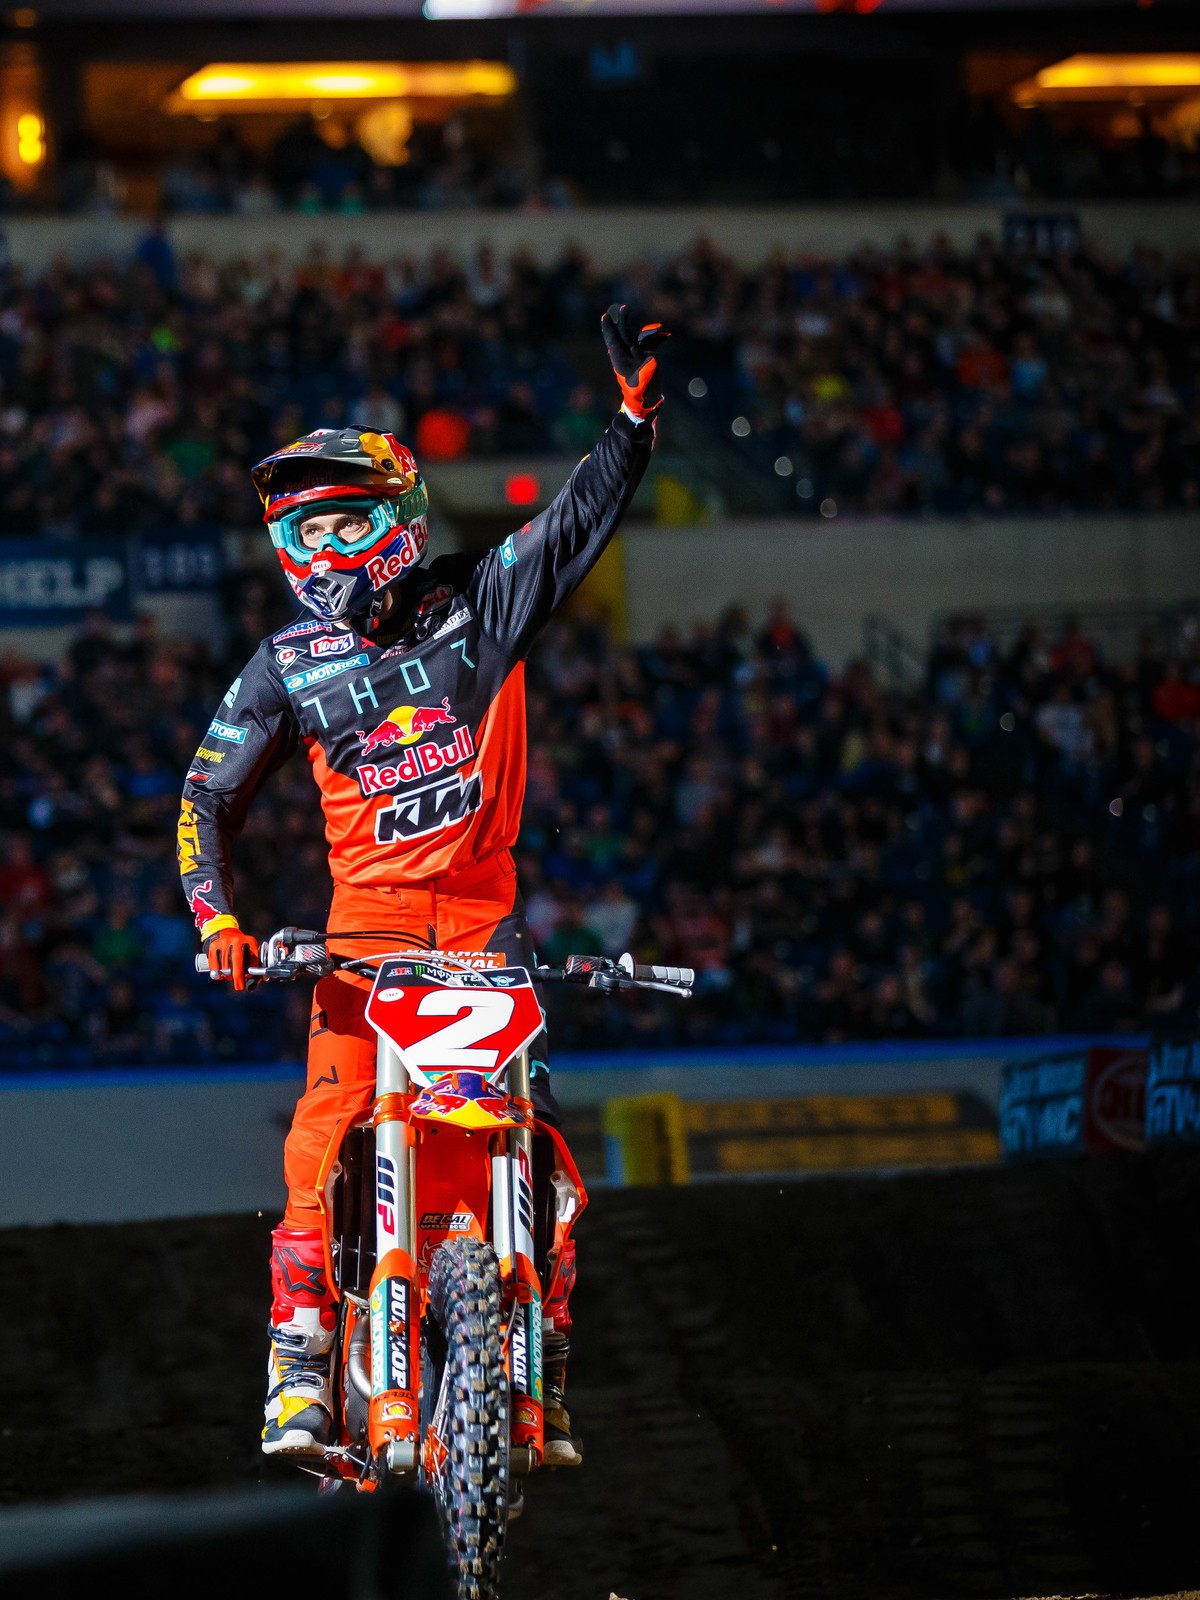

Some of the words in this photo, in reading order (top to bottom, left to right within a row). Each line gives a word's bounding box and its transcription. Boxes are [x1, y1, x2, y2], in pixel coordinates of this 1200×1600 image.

[367, 532, 415, 590] Red
[305, 657, 362, 683] MOTOREX
[314, 637, 349, 655] 100%
[358, 751, 419, 794] Red
[419, 726, 475, 777] Bull
[375, 771, 483, 844] KTM
[402, 989, 515, 1068] 2
[422, 1214, 468, 1224] DECAL
